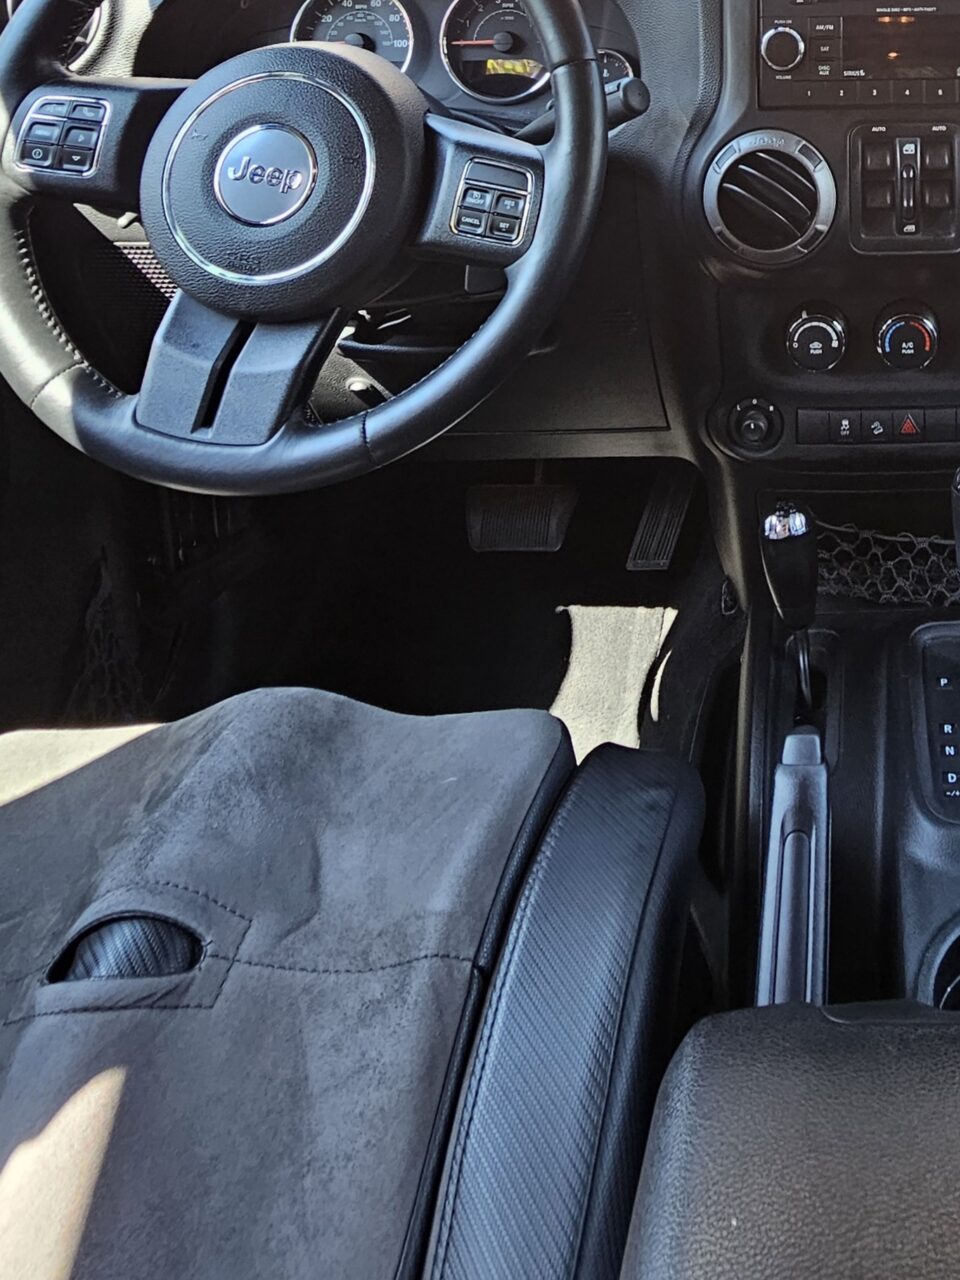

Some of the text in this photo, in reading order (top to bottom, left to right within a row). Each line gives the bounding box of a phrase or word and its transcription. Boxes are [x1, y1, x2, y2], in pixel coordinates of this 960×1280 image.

[370, 0, 381, 7] 60
[389, 14, 400, 22] 80
[393, 39, 407, 47] 100
[227, 156, 303, 194] Jeep
[461, 216, 480, 225] CANCEL
[901, 341, 914, 349] A/C
[940, 678, 948, 687] P
[944, 724, 952, 734] R
[945, 746, 955, 756] N
[947, 772, 957, 783] D
